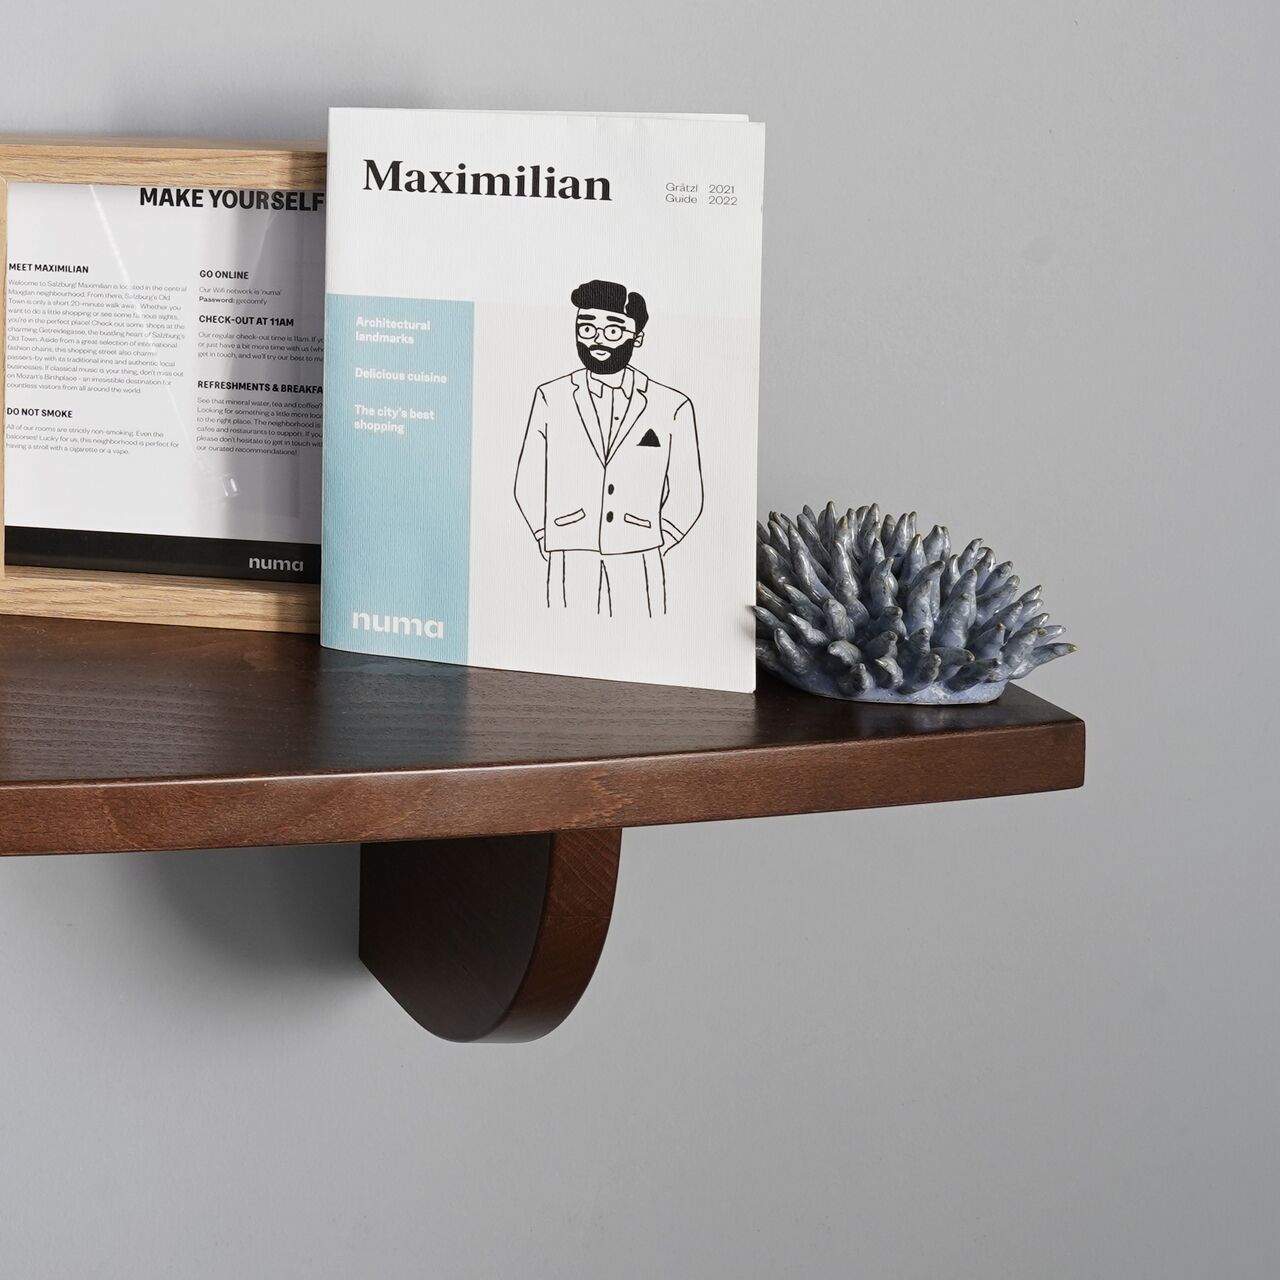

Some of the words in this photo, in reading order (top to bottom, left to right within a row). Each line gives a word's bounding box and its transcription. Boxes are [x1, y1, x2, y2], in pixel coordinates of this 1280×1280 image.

[362, 158, 612, 201] Maximilian
[708, 184, 735, 194] 2021
[140, 187, 204, 207] MAKE
[208, 190, 325, 211] YOURSELF
[665, 193, 698, 204] Guide
[708, 195, 738, 206] 2022
[8, 263, 33, 272] MEET
[34, 264, 89, 274] MAXIMILIAN
[199, 270, 214, 278] GO
[215, 270, 249, 280] ONLINE
[199, 315, 254, 325] CHECK-OUT
[256, 317, 268, 326] AT
[269, 318, 294, 327] 11AM
[355, 316, 431, 331] Architectural
[355, 331, 415, 344] landmarks
[355, 367, 406, 381] Delicious
[407, 371, 448, 384] cuisine
[197, 380, 271, 392] REFRESHMENTS
[272, 383, 279, 392] &
[6, 407, 20, 416] DO
[21, 408, 40, 417] NOT
[41, 409, 73, 418] SMOKE
[354, 404, 376, 416] The
[409, 408, 435, 420] best
[353, 419, 405, 435] shopping
[249, 557, 304, 571] numa
[351, 610, 444, 640] numa
